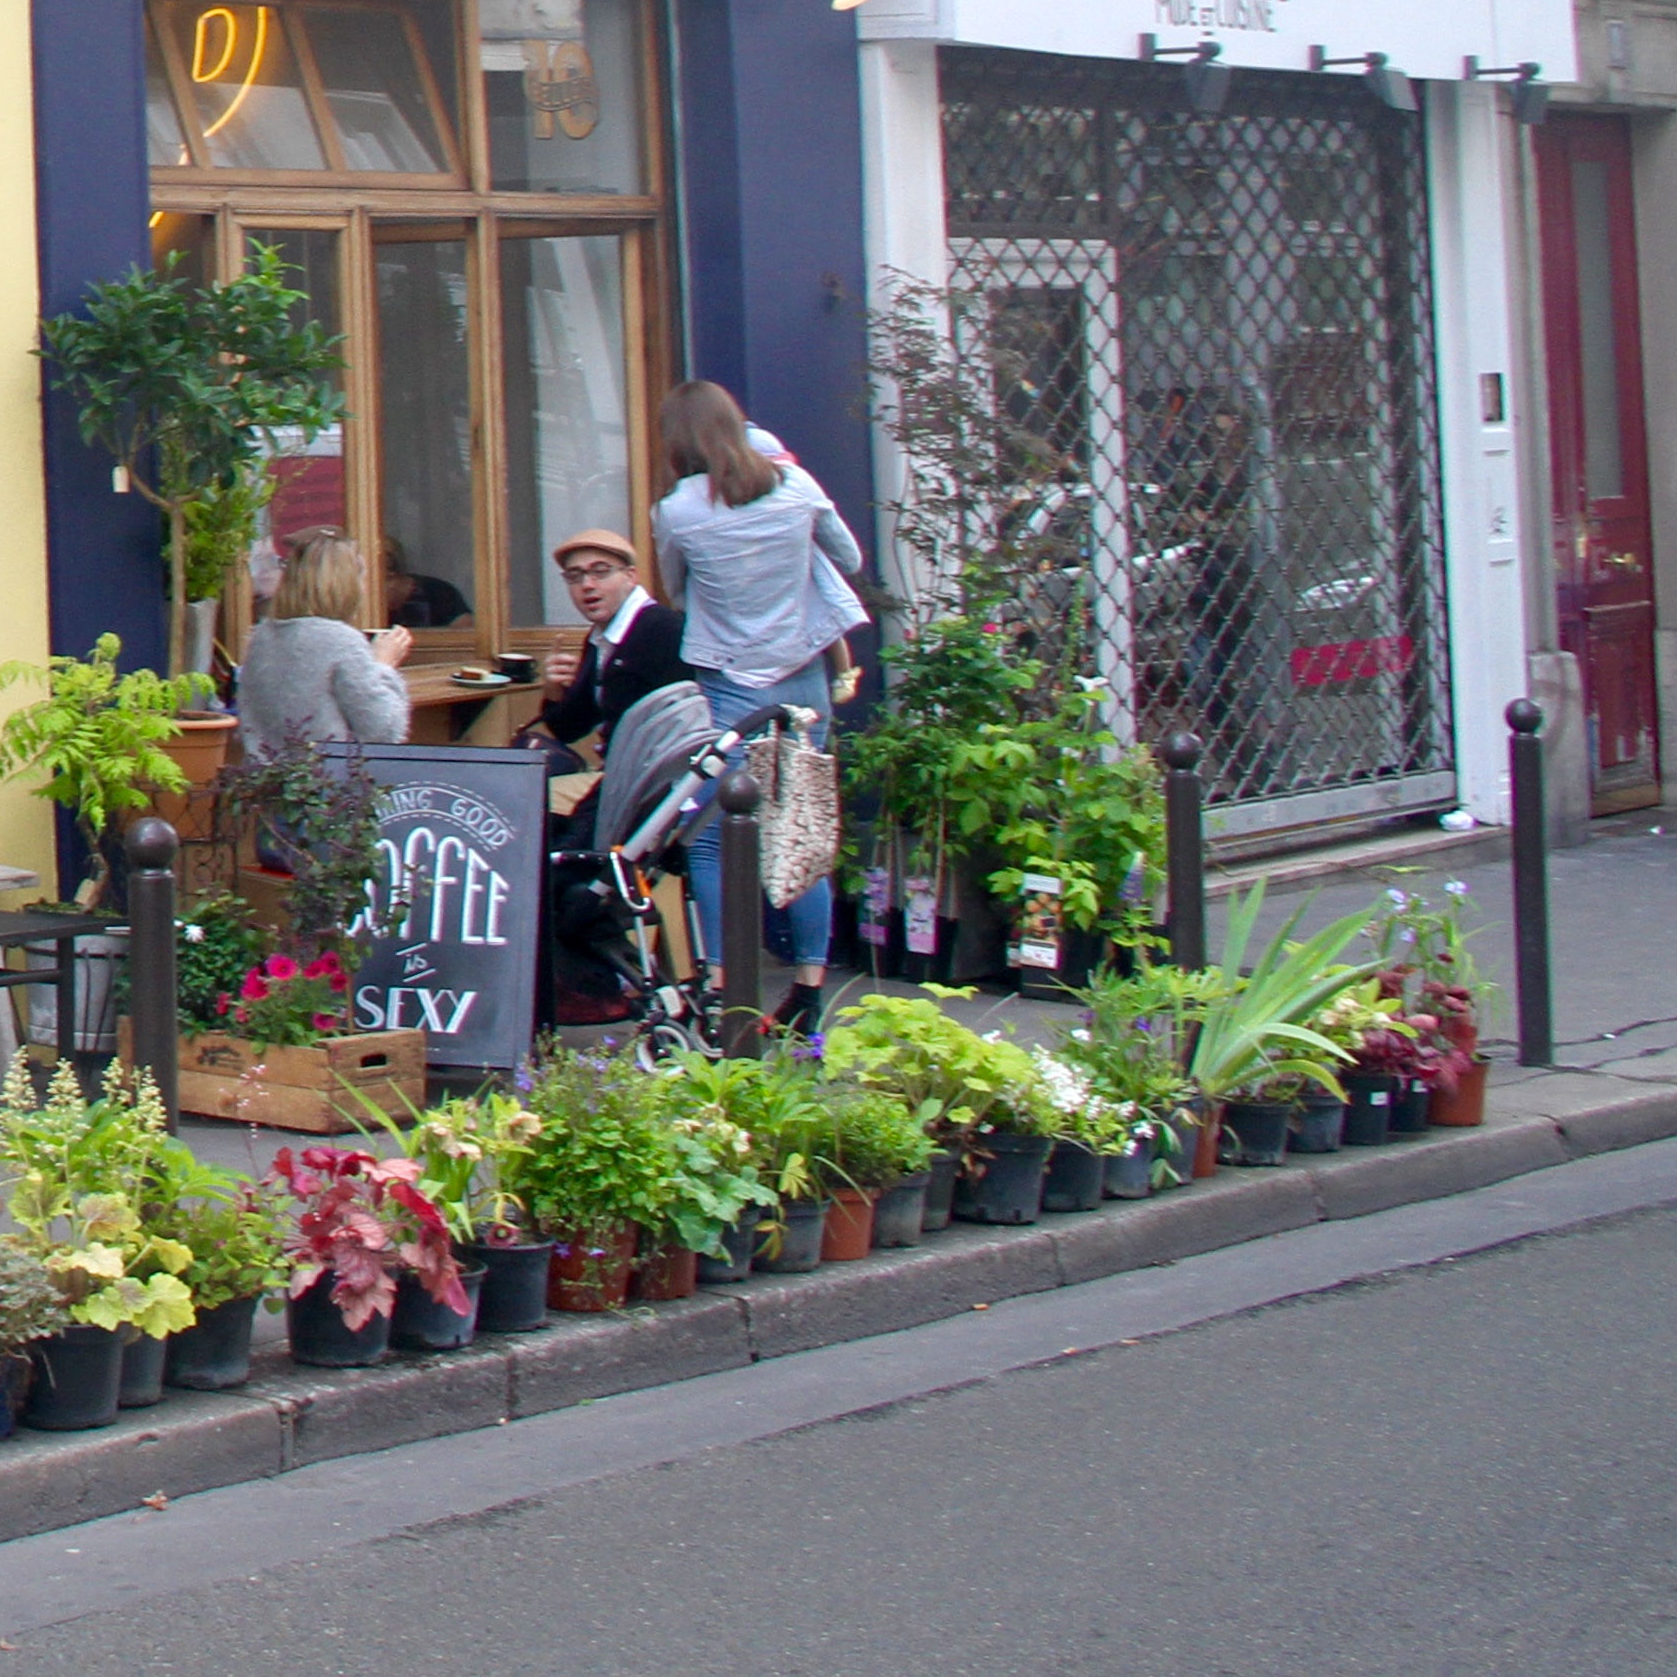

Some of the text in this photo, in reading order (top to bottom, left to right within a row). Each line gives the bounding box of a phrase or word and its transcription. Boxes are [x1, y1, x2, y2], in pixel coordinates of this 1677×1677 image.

[449, 798, 508, 846] GOOD
[338, 826, 512, 946] OFFEE
[354, 985, 478, 1034] SEXY
